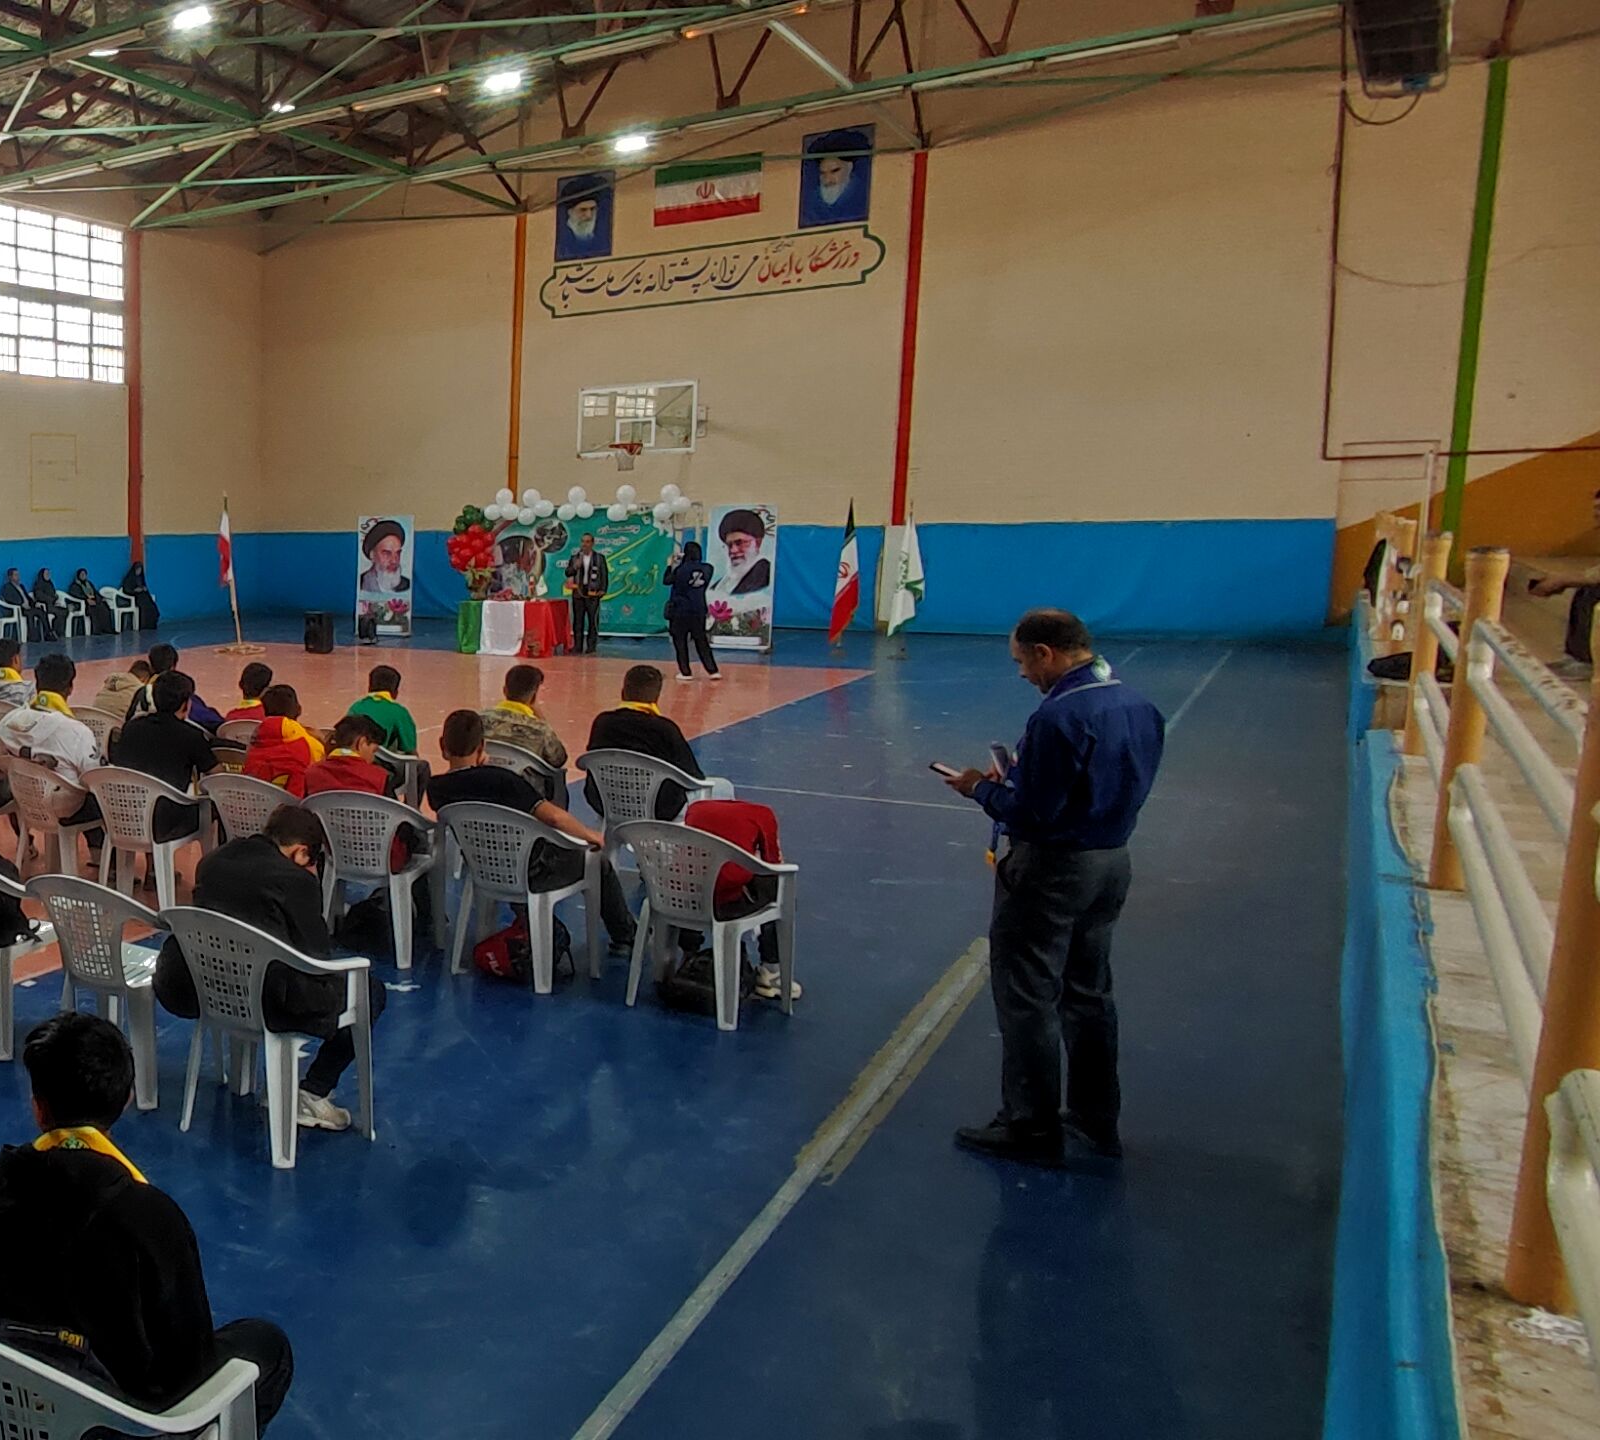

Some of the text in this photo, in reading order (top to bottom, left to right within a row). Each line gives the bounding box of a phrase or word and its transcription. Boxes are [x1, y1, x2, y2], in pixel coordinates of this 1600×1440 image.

[757, 251, 795, 285] ایمان
[808, 238, 861, 273] ورزشکار
[643, 256, 711, 294] پشتوانه
